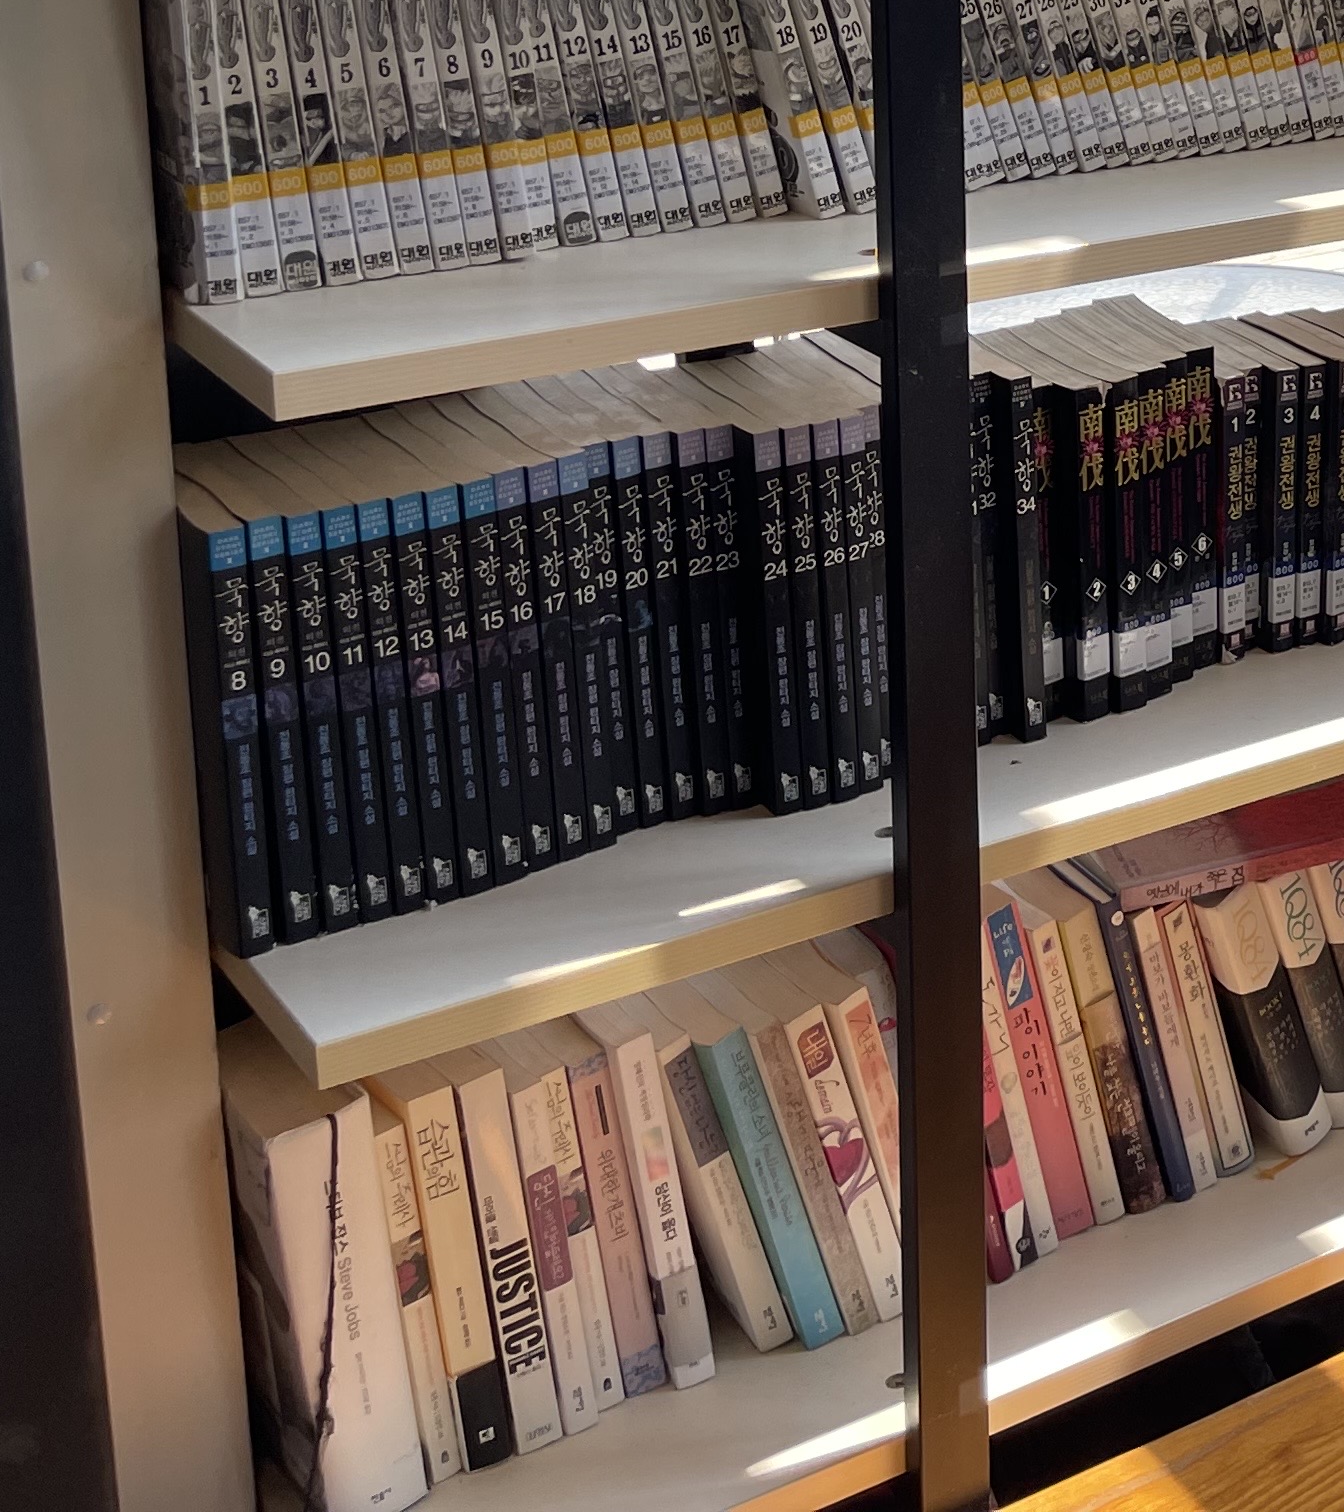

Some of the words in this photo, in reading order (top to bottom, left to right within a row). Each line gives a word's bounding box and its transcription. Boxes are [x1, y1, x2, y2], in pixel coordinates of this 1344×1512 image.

[1015, 0, 1033, 21] 27
[662, 30, 682, 50] 15
[723, 25, 740, 46] 17
[776, 25, 796, 47] 18
[841, 20, 862, 41] 20
[565, 35, 587, 57] 12
[629, 33, 651, 54] 13
[378, 57, 391, 78] 6
[413, 57, 425, 78] 7
[446, 55, 459, 75] 8
[481, 49, 494, 69] 9
[266, 68, 279, 89] 3
[304, 68, 318, 88] 4
[340, 63, 353, 84] 5
[228, 74, 243, 95] 2
[1231, 416, 1239, 432] 1
[1283, 408, 1294, 424] 3
[398, 541, 430, 605] 묵향
[764, 561, 788, 581] 24
[292, 561, 326, 627] 묵향
[215, 576, 250, 644] 묵향
[408, 629, 435, 651] 13
[304, 652, 331, 673] 10
[230, 670, 246, 691] 8
[1279, 875, 1312, 959] 1Q84
[1231, 896, 1269, 985] 1Q84
[1011, 1007, 1041, 1037] 파이
[1022, 1046, 1048, 1097] 이야기
[337, 1256, 353, 1302] Steve
[490, 1238, 547, 1376] JUSTICE
[344, 1304, 360, 1341] Jobs
